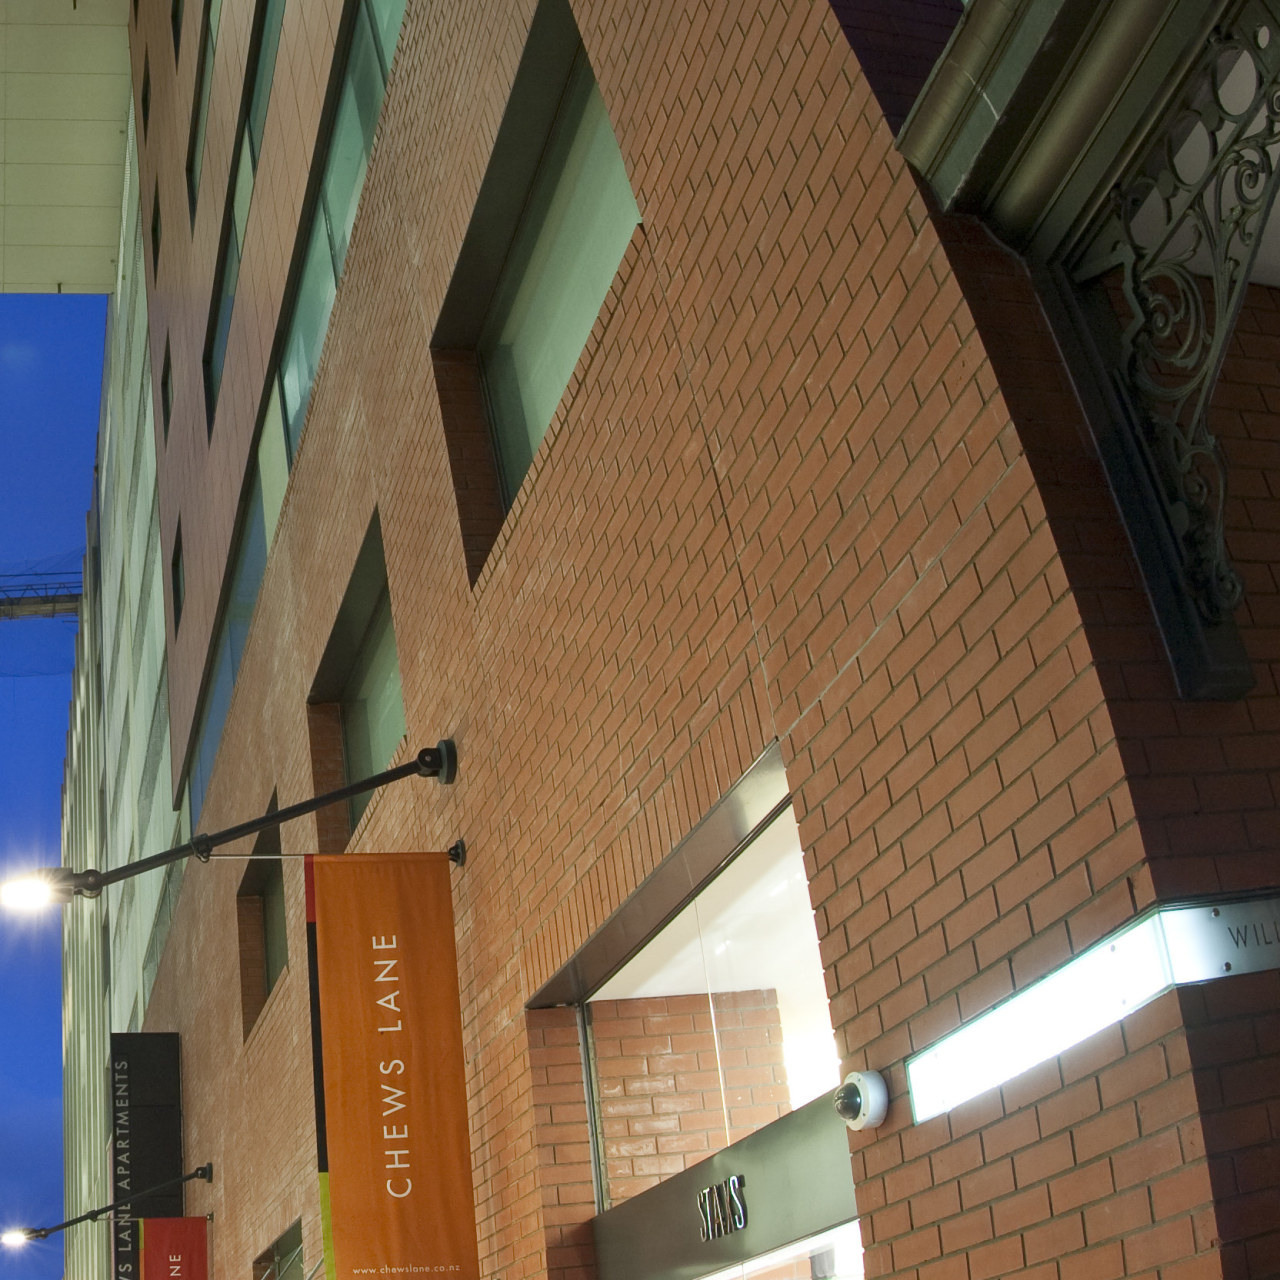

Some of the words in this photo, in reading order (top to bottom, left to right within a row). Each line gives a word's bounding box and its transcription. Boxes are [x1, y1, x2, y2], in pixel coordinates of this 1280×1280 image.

[372, 934, 402, 1033] LANE
[115, 1060, 131, 1190] APARTMENTS
[379, 1059, 412, 1198] CHEWS
[351, 1263, 461, 1275] www.chewslane.co.nz
